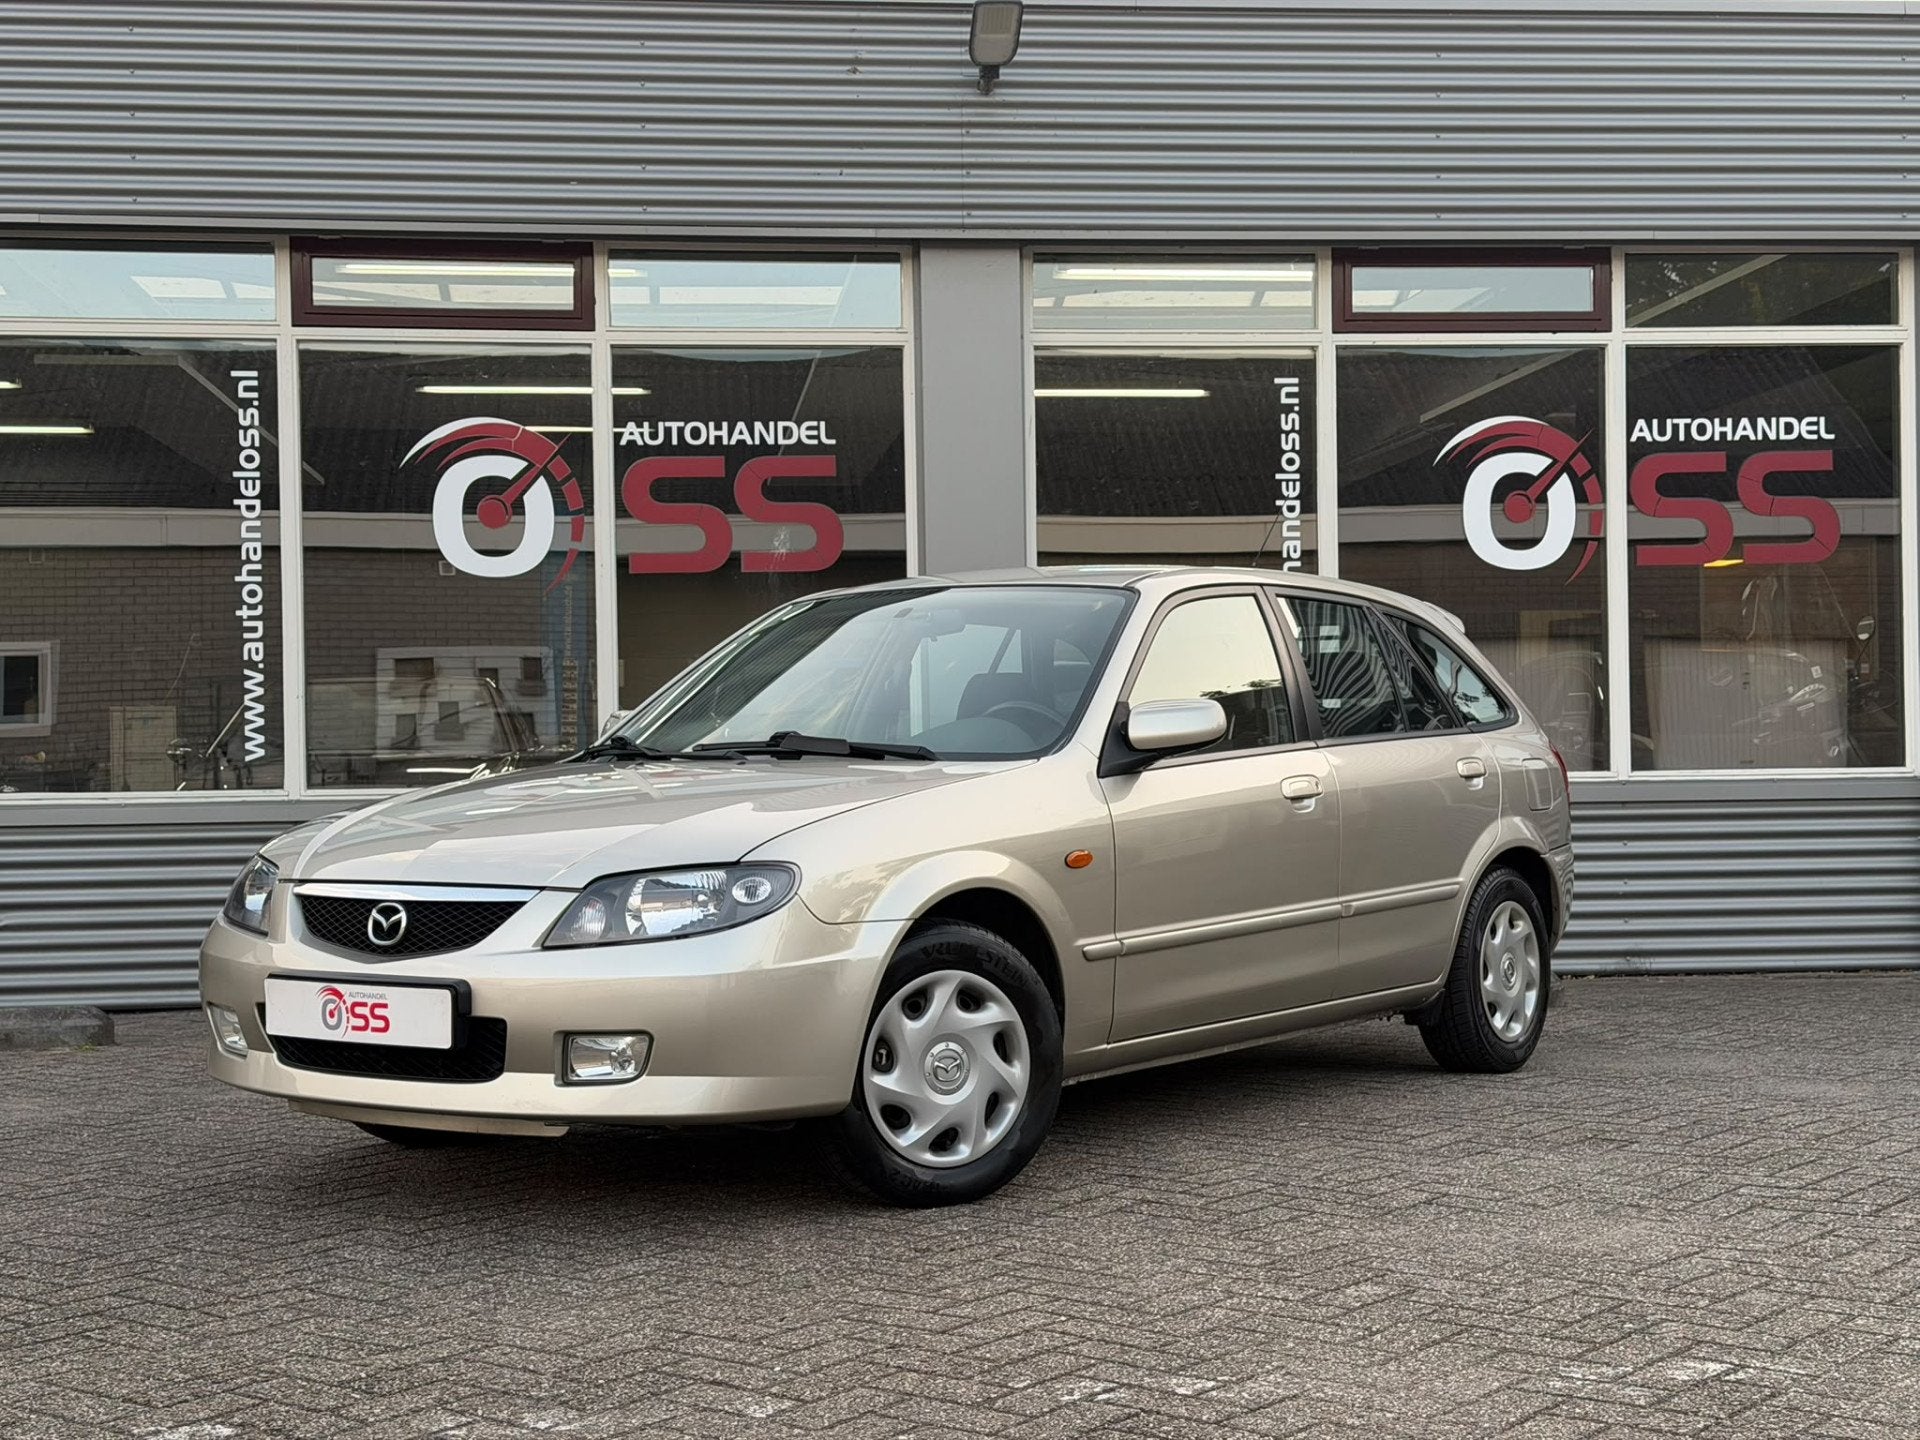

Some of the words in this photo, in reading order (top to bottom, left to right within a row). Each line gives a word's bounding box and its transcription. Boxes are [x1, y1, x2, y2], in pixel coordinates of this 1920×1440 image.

[620, 420, 836, 446] AUTOHANDEL
[1630, 416, 1836, 442] AUTOHANDEL
[230, 370, 265, 762] www.autohandeloss.nl
[348, 990, 388, 1001] AUTOHANDEL
